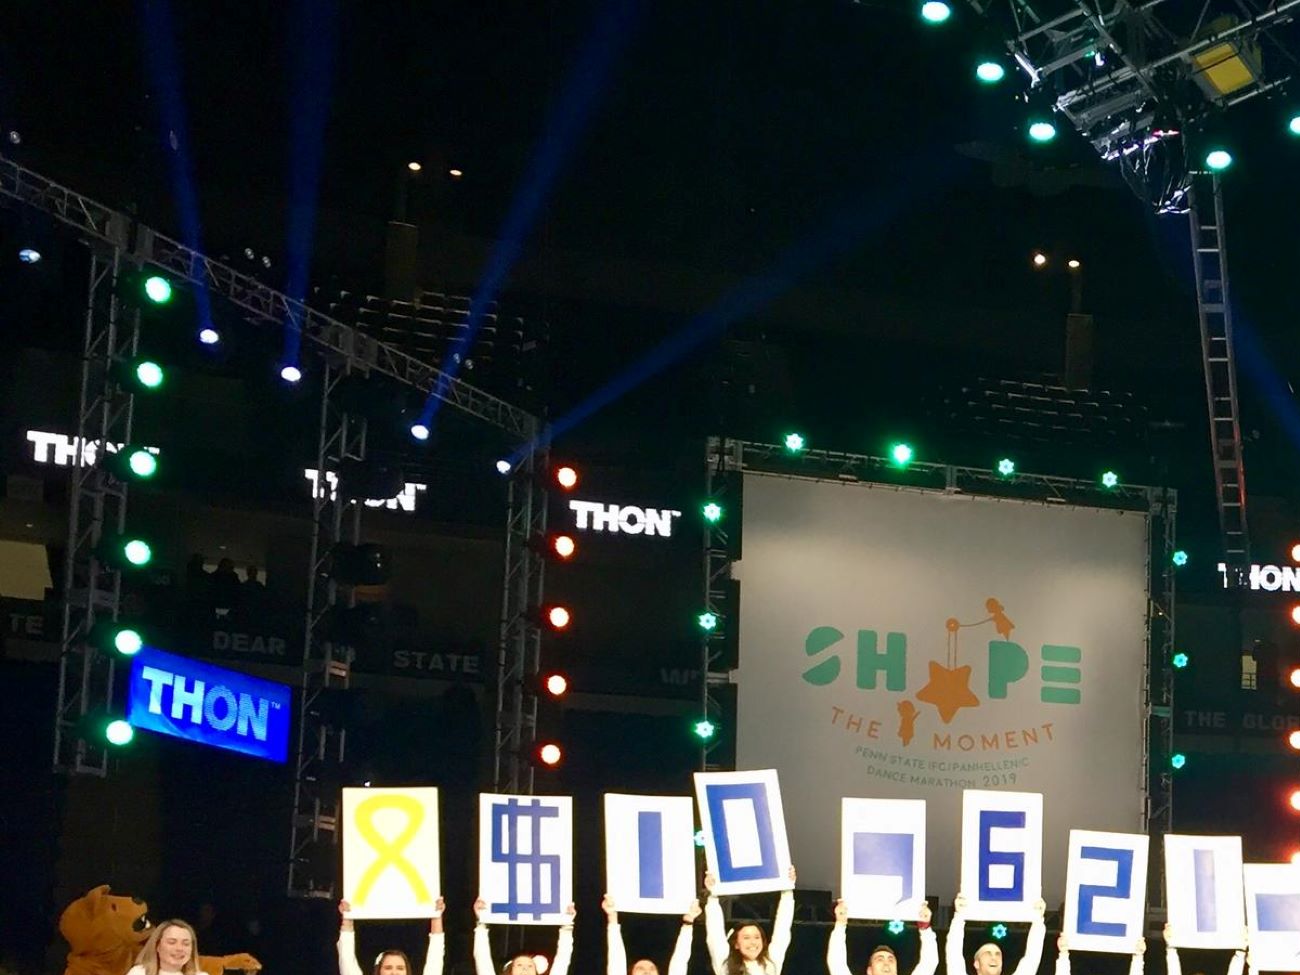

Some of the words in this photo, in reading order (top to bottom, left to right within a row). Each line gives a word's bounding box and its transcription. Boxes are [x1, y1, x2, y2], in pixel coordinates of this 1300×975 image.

[212, 631, 288, 656] DEAR
[392, 650, 480, 674] STATE
[831, 706, 882, 739] THE
[932, 723, 1056, 751] MOMENT
[856, 745, 888, 763] PENN
[889, 754, 927, 771] STATE
[866, 765, 906, 783] DANCE
[910, 776, 977, 788] MARATHON
[982, 773, 1018, 788] 2019
